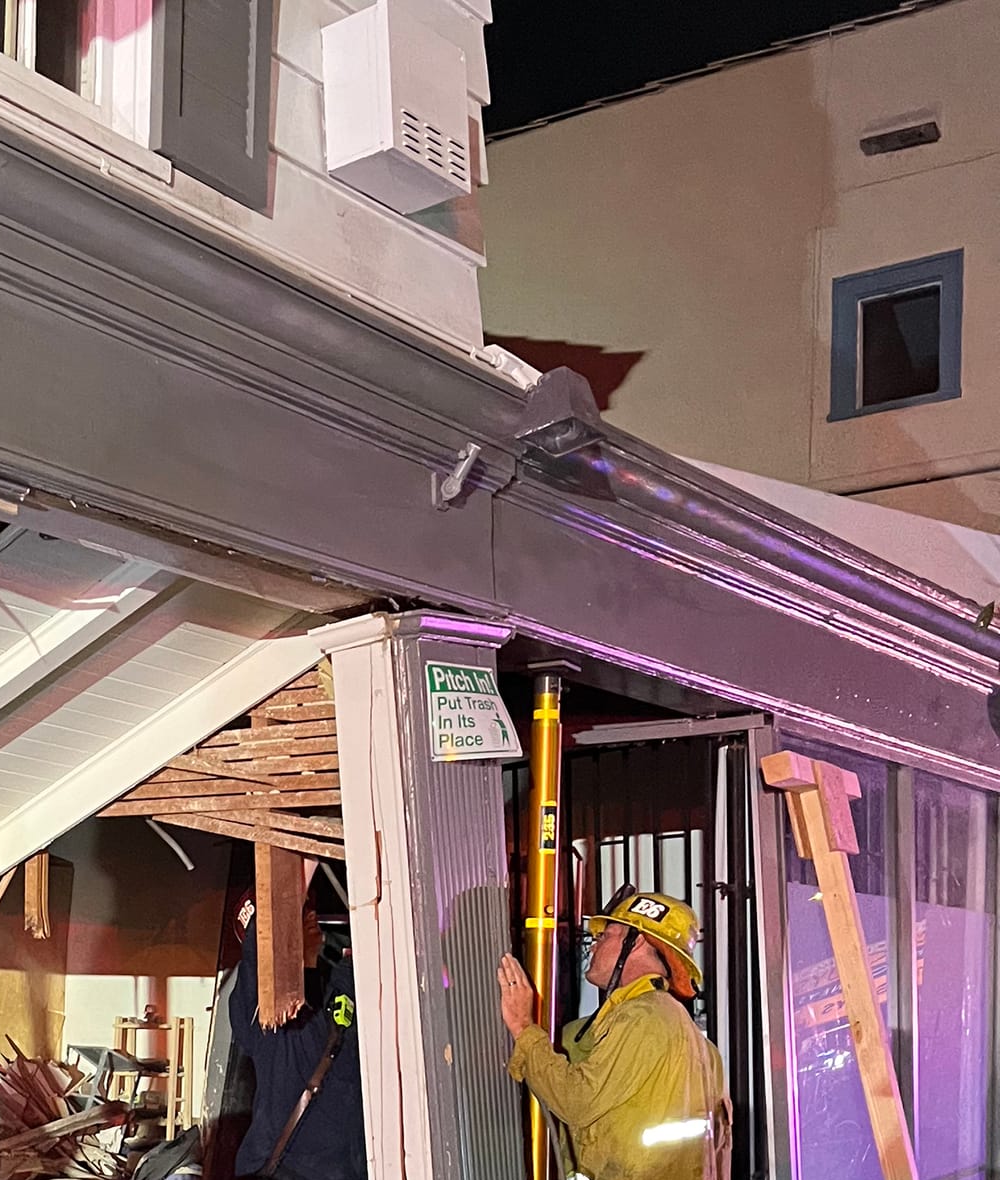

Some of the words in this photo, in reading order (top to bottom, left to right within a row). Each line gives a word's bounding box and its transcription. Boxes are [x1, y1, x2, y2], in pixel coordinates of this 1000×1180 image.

[432, 667, 476, 692] Pitch
[473, 672, 494, 694] In!
[437, 696, 462, 711] Put
[464, 696, 498, 712] Trash
[439, 715, 453, 729] In
[458, 714, 476, 729] Its
[439, 733, 484, 748] Place
[630, 898, 666, 919] E6
